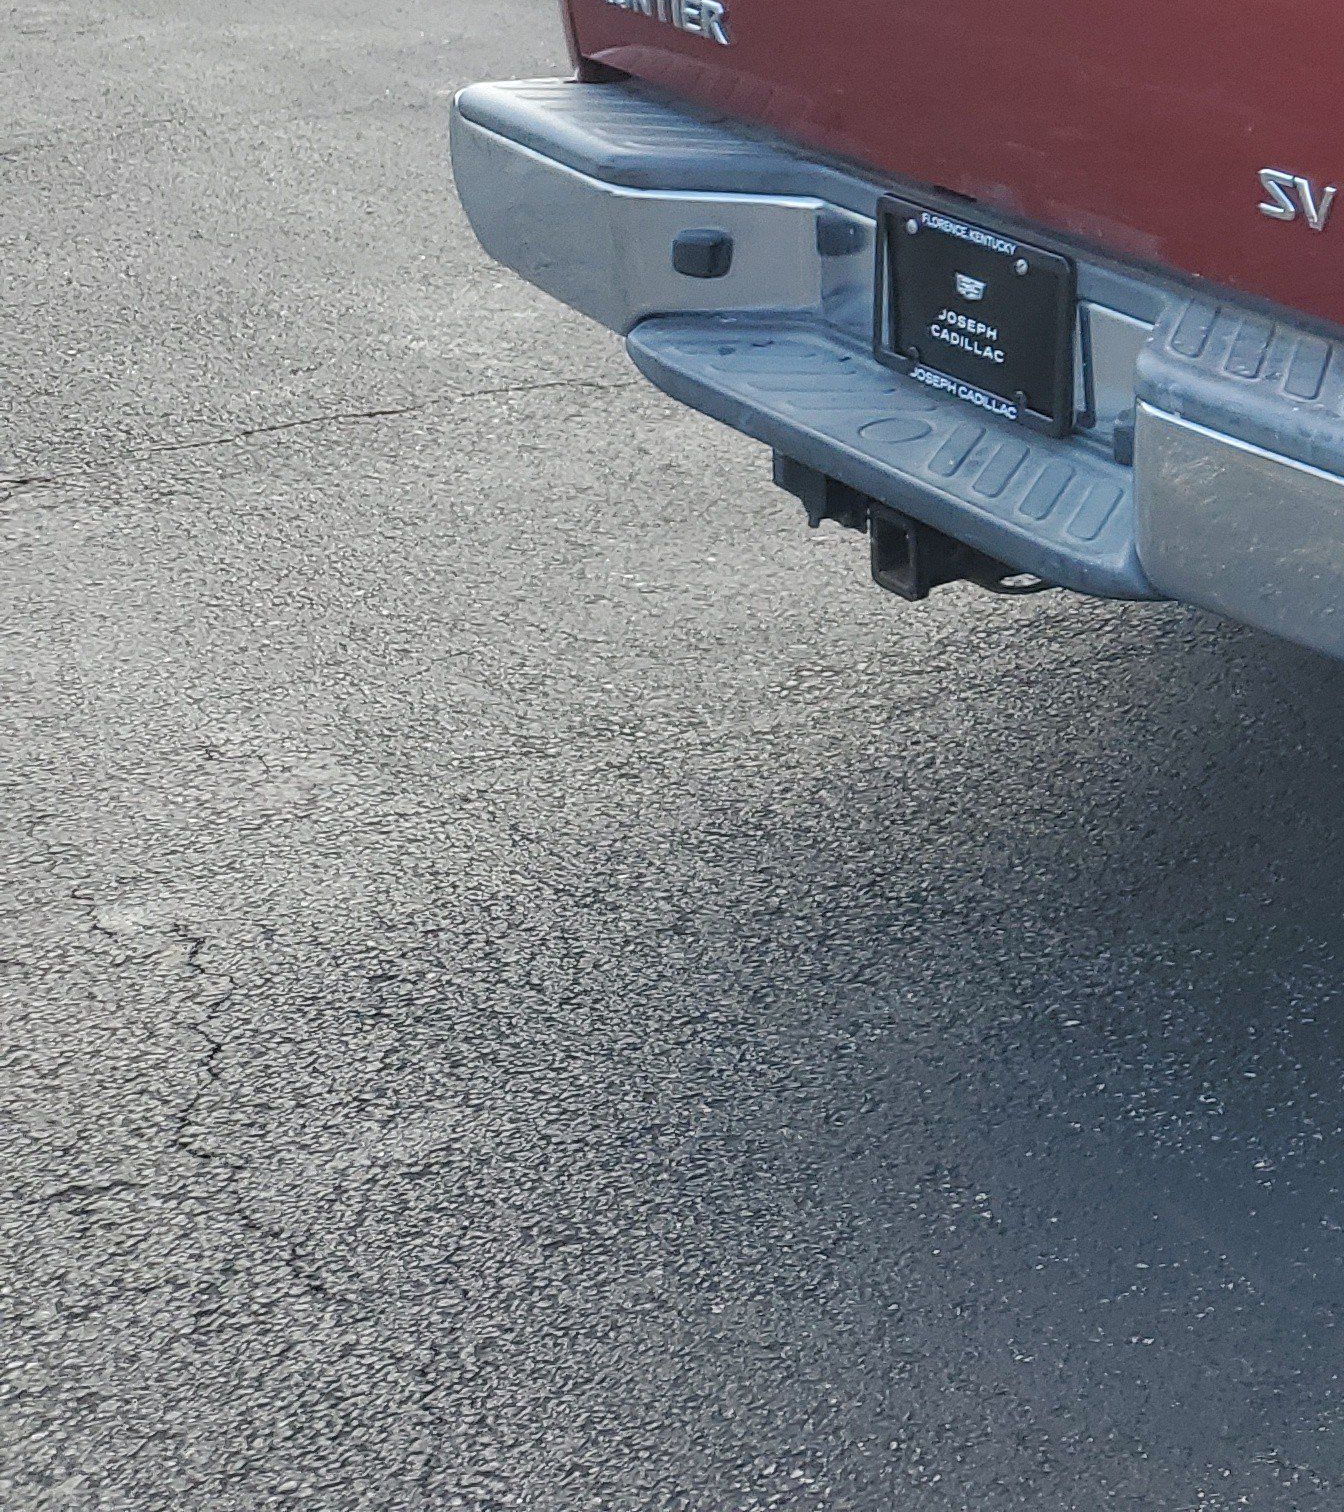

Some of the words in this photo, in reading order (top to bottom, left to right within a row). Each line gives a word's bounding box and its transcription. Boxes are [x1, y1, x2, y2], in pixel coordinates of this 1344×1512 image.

[1257, 167, 1338, 232] SV
[968, 229, 1017, 256] KENTUCKY
[930, 324, 1005, 364] CADILLAC
[938, 308, 998, 341] JOSEPH
[909, 366, 957, 395] JOSEPH
[957, 385, 1018, 420] CADILLAC
